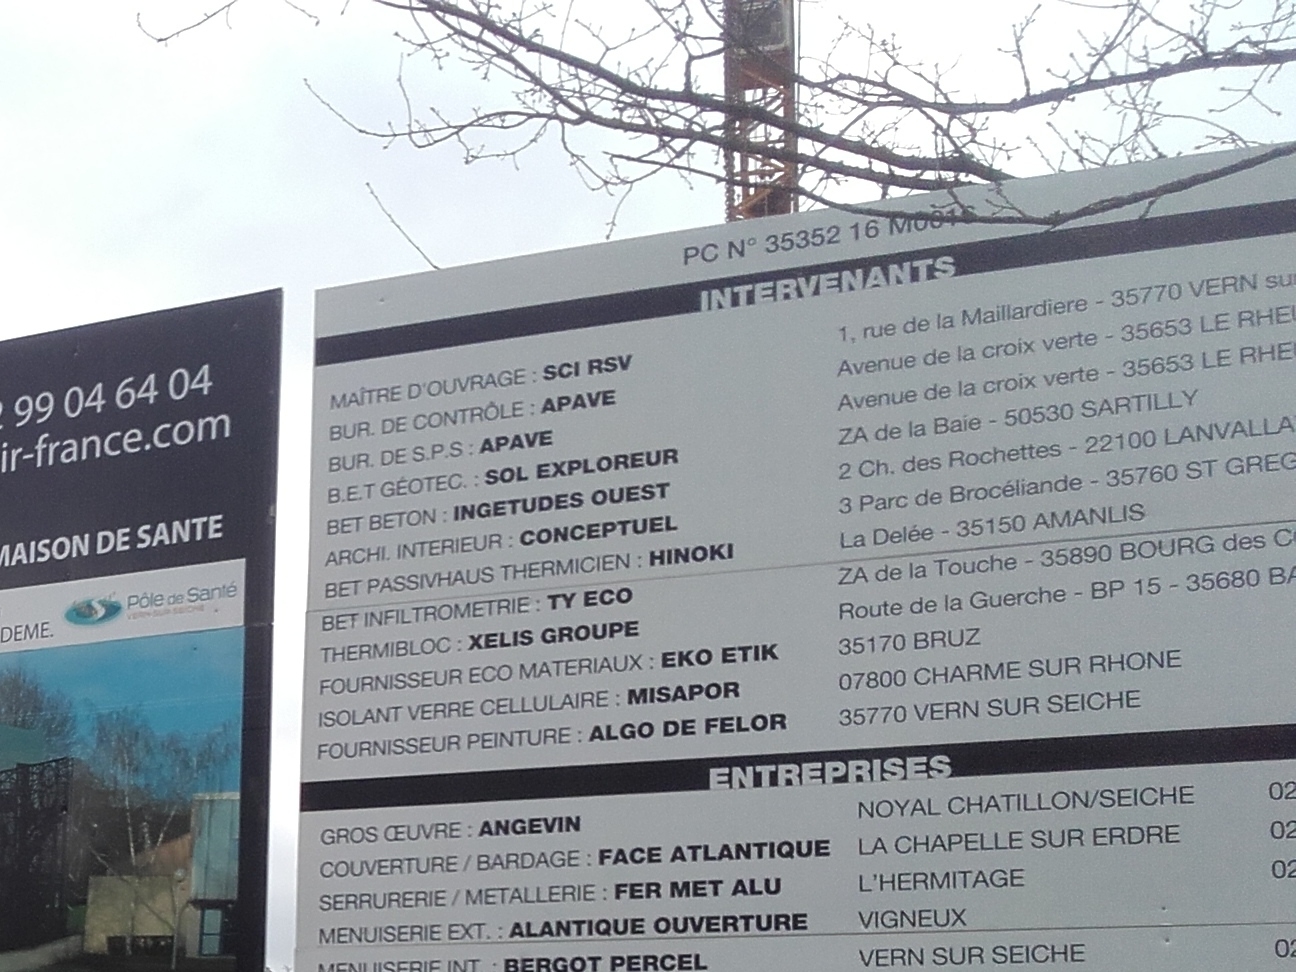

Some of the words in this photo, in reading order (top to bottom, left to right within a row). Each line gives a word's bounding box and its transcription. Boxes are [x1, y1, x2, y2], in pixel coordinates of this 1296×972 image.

[683, 242, 719, 266] PC
[727, 237, 757, 260] N°
[765, 224, 841, 254] 35352
[849, 219, 880, 241] 16
[700, 255, 955, 312] INTERVENANTS
[14, 391, 55, 428] 99
[64, 382, 107, 418] 04
[115, 373, 159, 410] 64
[168, 363, 213, 401] 04
[330, 385, 401, 409] MAÎTRE
[407, 368, 526, 400] D'OUVRAGE
[542, 361, 580, 381] SCI
[587, 354, 633, 376] RSV
[837, 426, 869, 446] ZA
[874, 423, 902, 442] de
[908, 420, 927, 438] la
[933, 414, 982, 435] Baie
[1004, 402, 1074, 427] 50530
[1080, 388, 1199, 419] SARTILLY
[328, 483, 376, 504] B.E.T
[380, 473, 467, 498] GÉOTEC.
[484, 466, 529, 486] SOL
[536, 448, 679, 480] EXPLOREUR
[96, 527, 131, 555] DE
[136, 514, 223, 549] SANTE
[324, 546, 390, 567] ARCHI.
[397, 533, 502, 559] INTERIEUR
[519, 515, 679, 547] CONCEPTUEL
[127, 592, 164, 610] Pôle
[167, 593, 184, 604] de
[187, 581, 238, 603] Santé
[320, 636, 451, 663] THERMIBLOC
[467, 629, 534, 651] XELIS
[540, 620, 640, 645] GROUPE
[838, 633, 906, 656] 35170
[913, 627, 981, 650] BRUZ
[838, 669, 907, 691] 07800
[913, 660, 1022, 686] CHARME
[1028, 656, 1082, 678] SUR
[1088, 649, 1182, 674] RHONE
[318, 705, 403, 728] ISOLANT
[407, 700, 474, 721] VERRE
[480, 690, 609, 716] CELLULAIRE
[627, 681, 740, 706] MISAPOR
[708, 753, 953, 792] ENTREPRISES
[858, 797, 942, 819] NOYAL
[947, 785, 1195, 815] CHATILLON/SEICHE
[320, 826, 379, 846] GROS
[383, 821, 461, 842] ŒUVRE
[478, 815, 581, 837] ANGEVIN
[858, 836, 888, 856] LA
[894, 830, 1024, 855] CHAPELLE
[1030, 828, 1085, 849] SUR
[1092, 824, 1181, 847] ERDRE
[319, 855, 458, 878] COUVERTURE
[477, 849, 580, 871] BARDAGE
[598, 846, 662, 866] FACE
[669, 839, 831, 863] ATLANTIQUE
[319, 889, 447, 912] SERRURERIE
[465, 884, 596, 905] METALLERIE
[614, 881, 662, 901] FER
[669, 879, 724, 899] MET
[731, 877, 782, 897] ALU
[859, 868, 1025, 893] L'HERMITAGE
[319, 924, 442, 944] MENUISERIE
[448, 922, 491, 941] EXT.
[508, 917, 646, 939] ALANTIQUE
[653, 912, 808, 935] OUVERTURE
[858, 908, 967, 929] VIGNEUX
[610, 953, 709, 972] PERCEL
